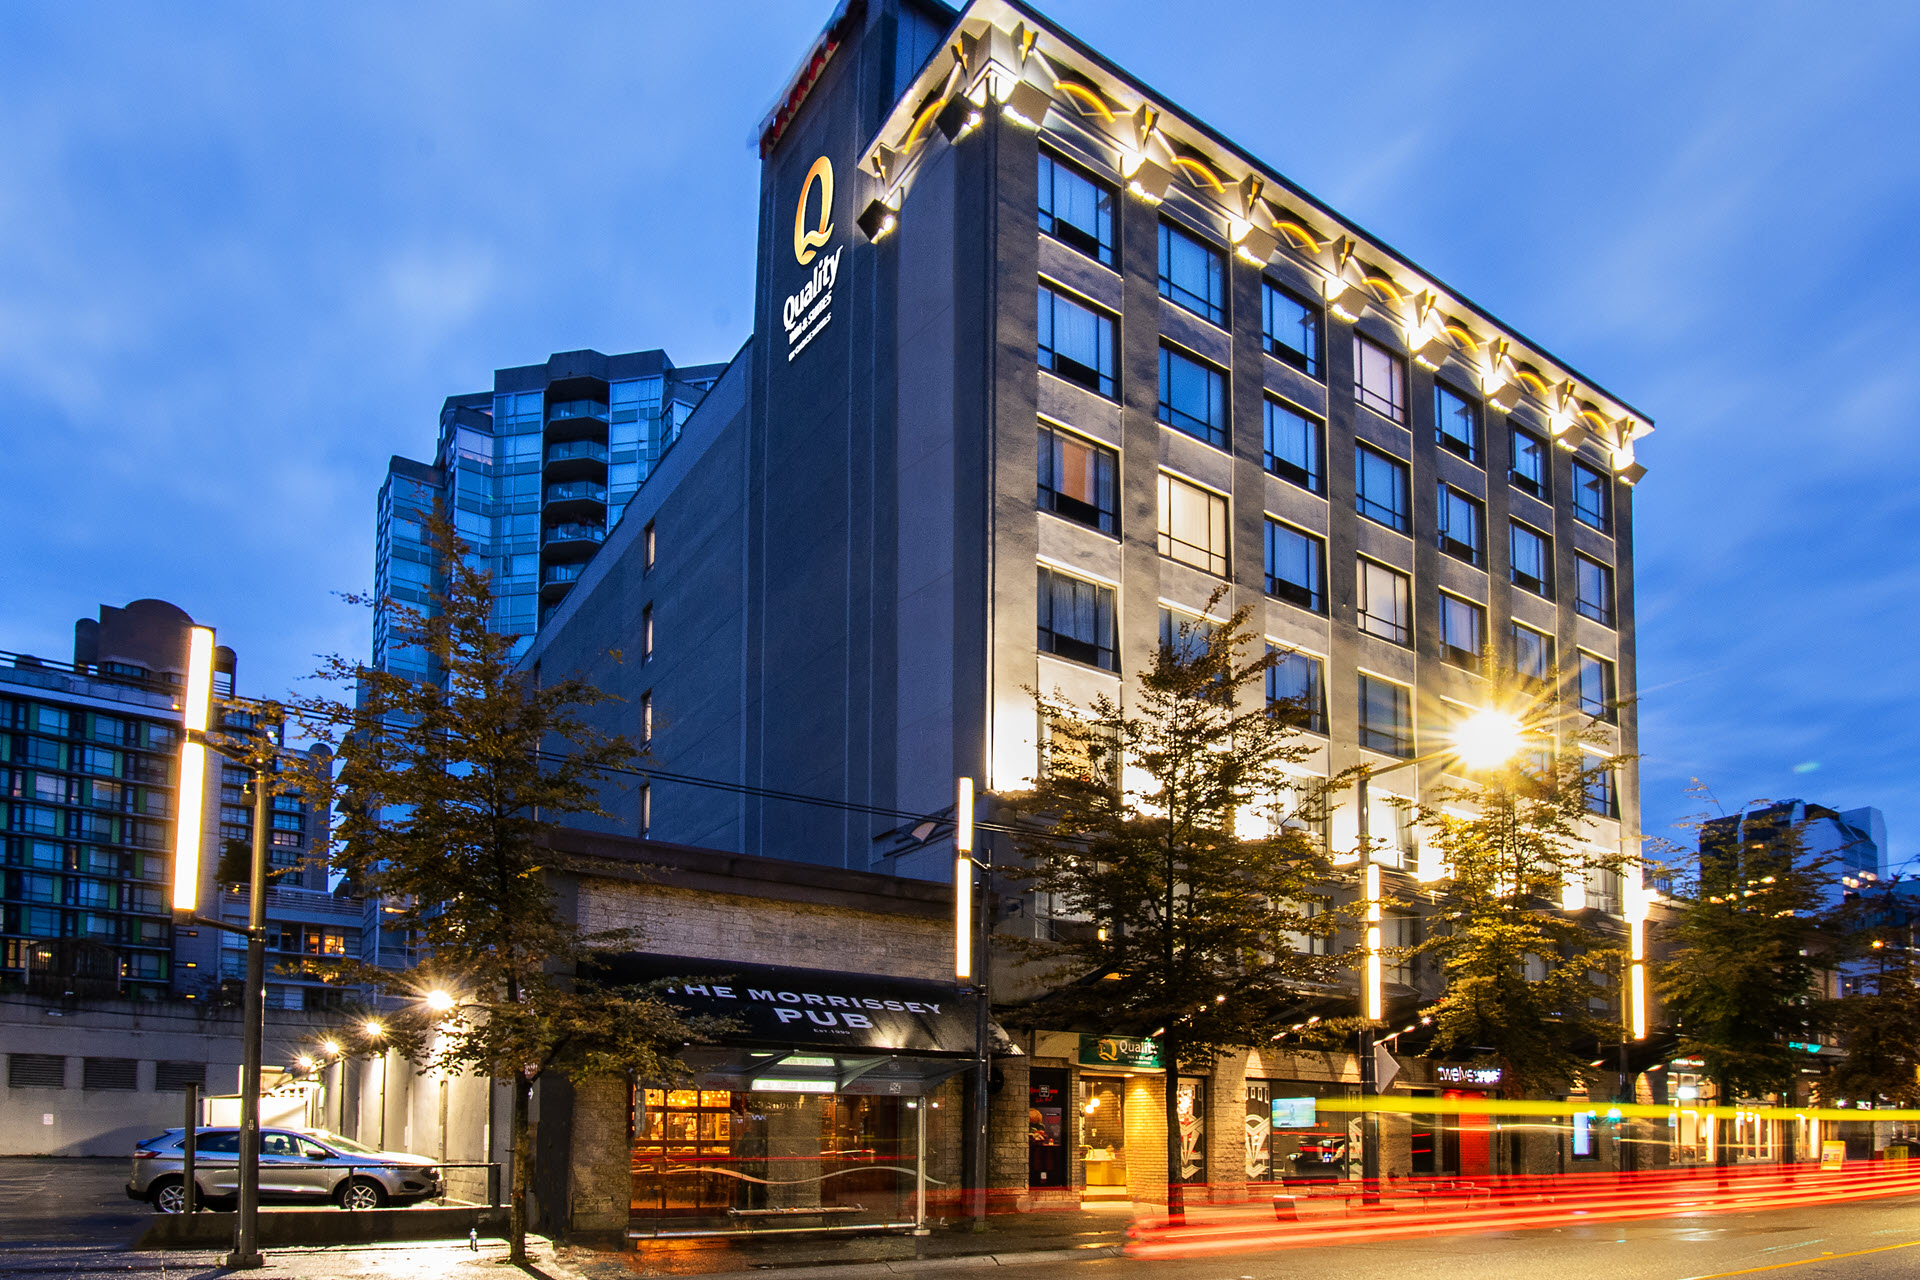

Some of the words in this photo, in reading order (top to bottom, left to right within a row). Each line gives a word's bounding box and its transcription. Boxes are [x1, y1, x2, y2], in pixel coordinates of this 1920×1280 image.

[794, 155, 834, 266] Q
[783, 245, 844, 332] Quality
[747, 988, 941, 1015] MORRISSEY
[773, 1007, 873, 1029] PUB
[1098, 1039, 1118, 1061] Q
